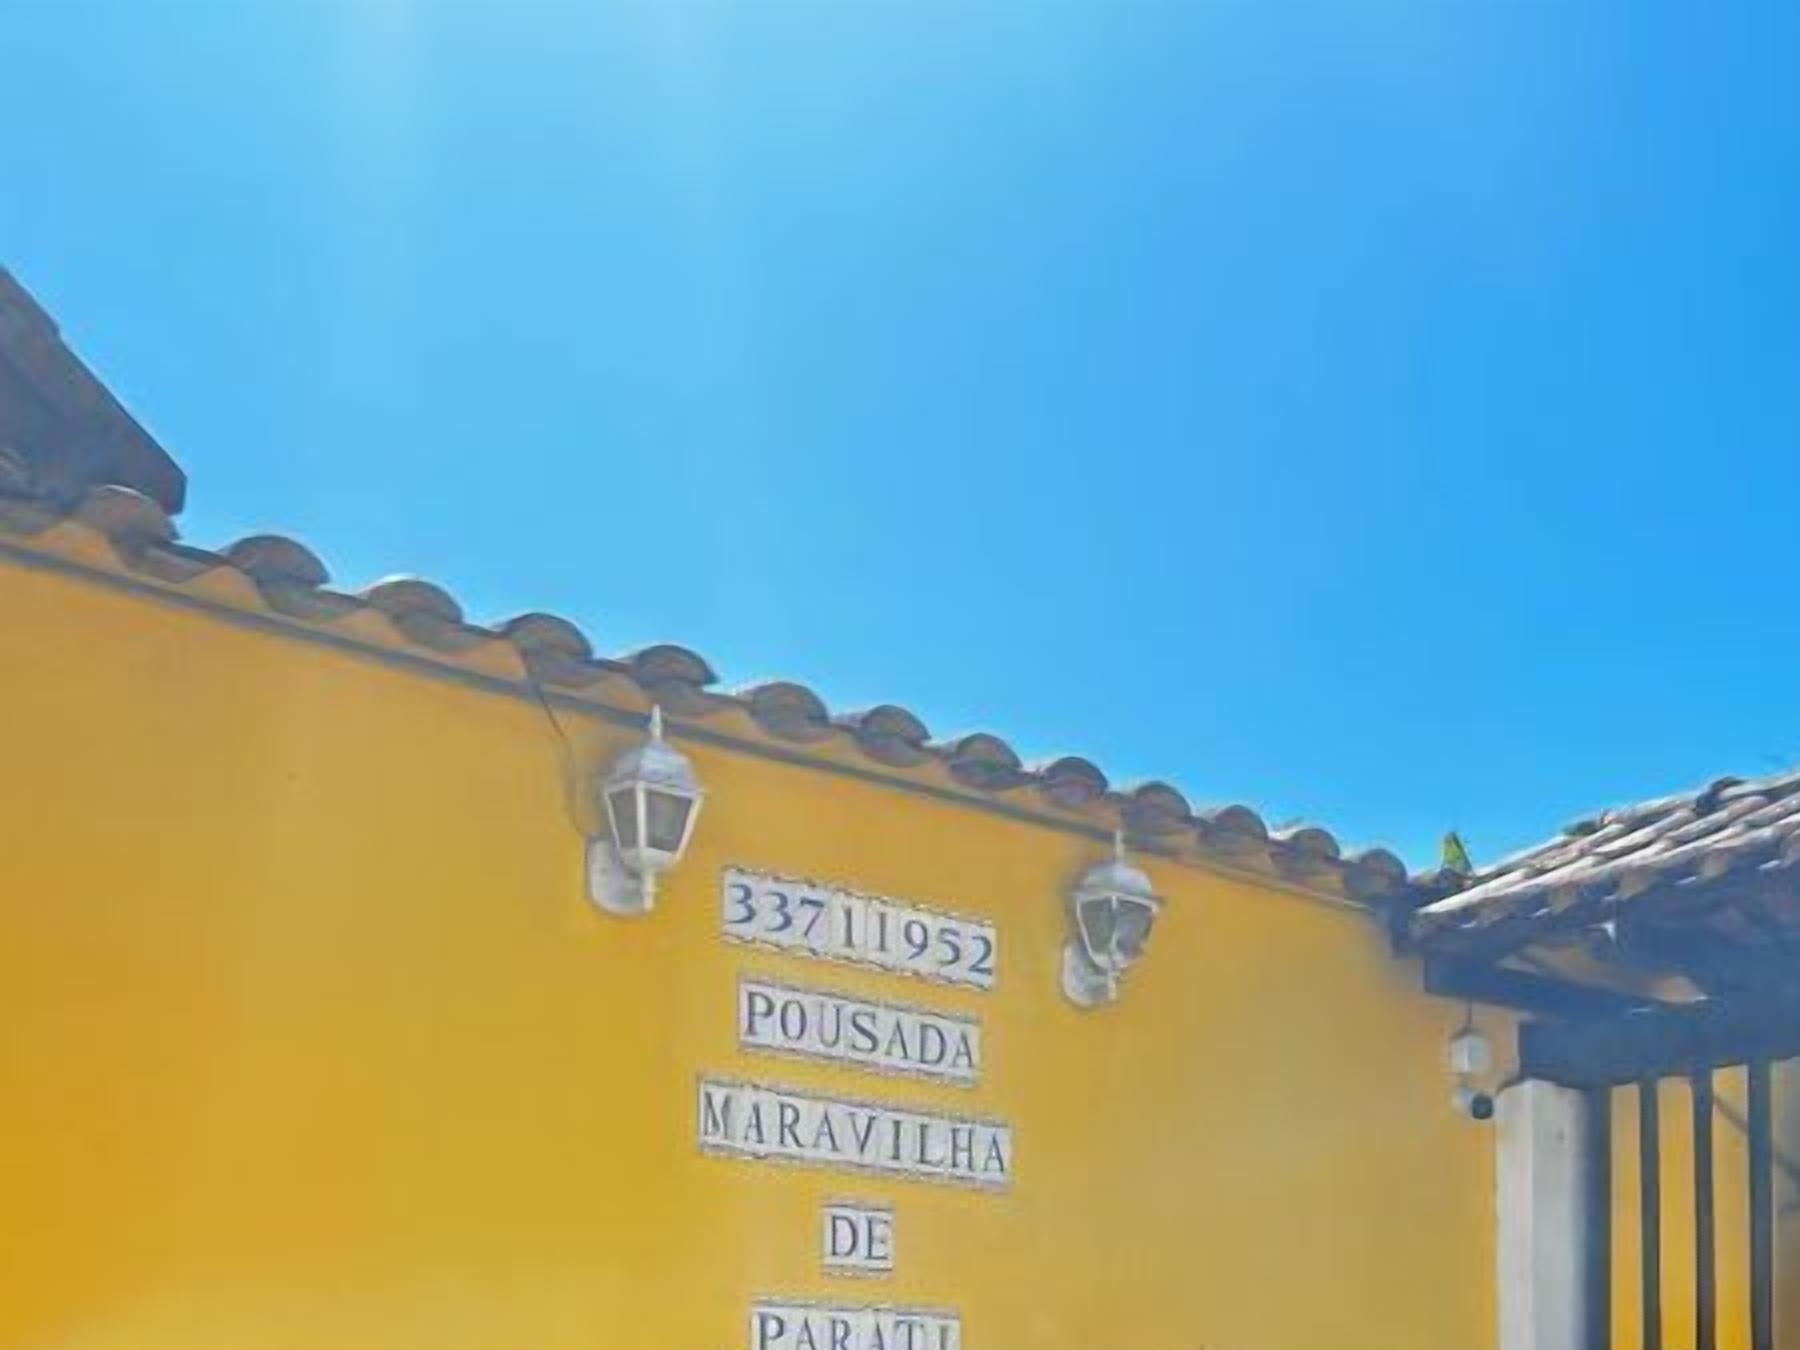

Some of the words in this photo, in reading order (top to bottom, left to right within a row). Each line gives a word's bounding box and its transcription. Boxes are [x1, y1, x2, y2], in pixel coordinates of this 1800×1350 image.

[727, 883, 993, 976] 33711952
[745, 990, 975, 1068] POUSADA
[704, 1090, 1006, 1173] MARAVILHA
[829, 1214, 891, 1261] DE
